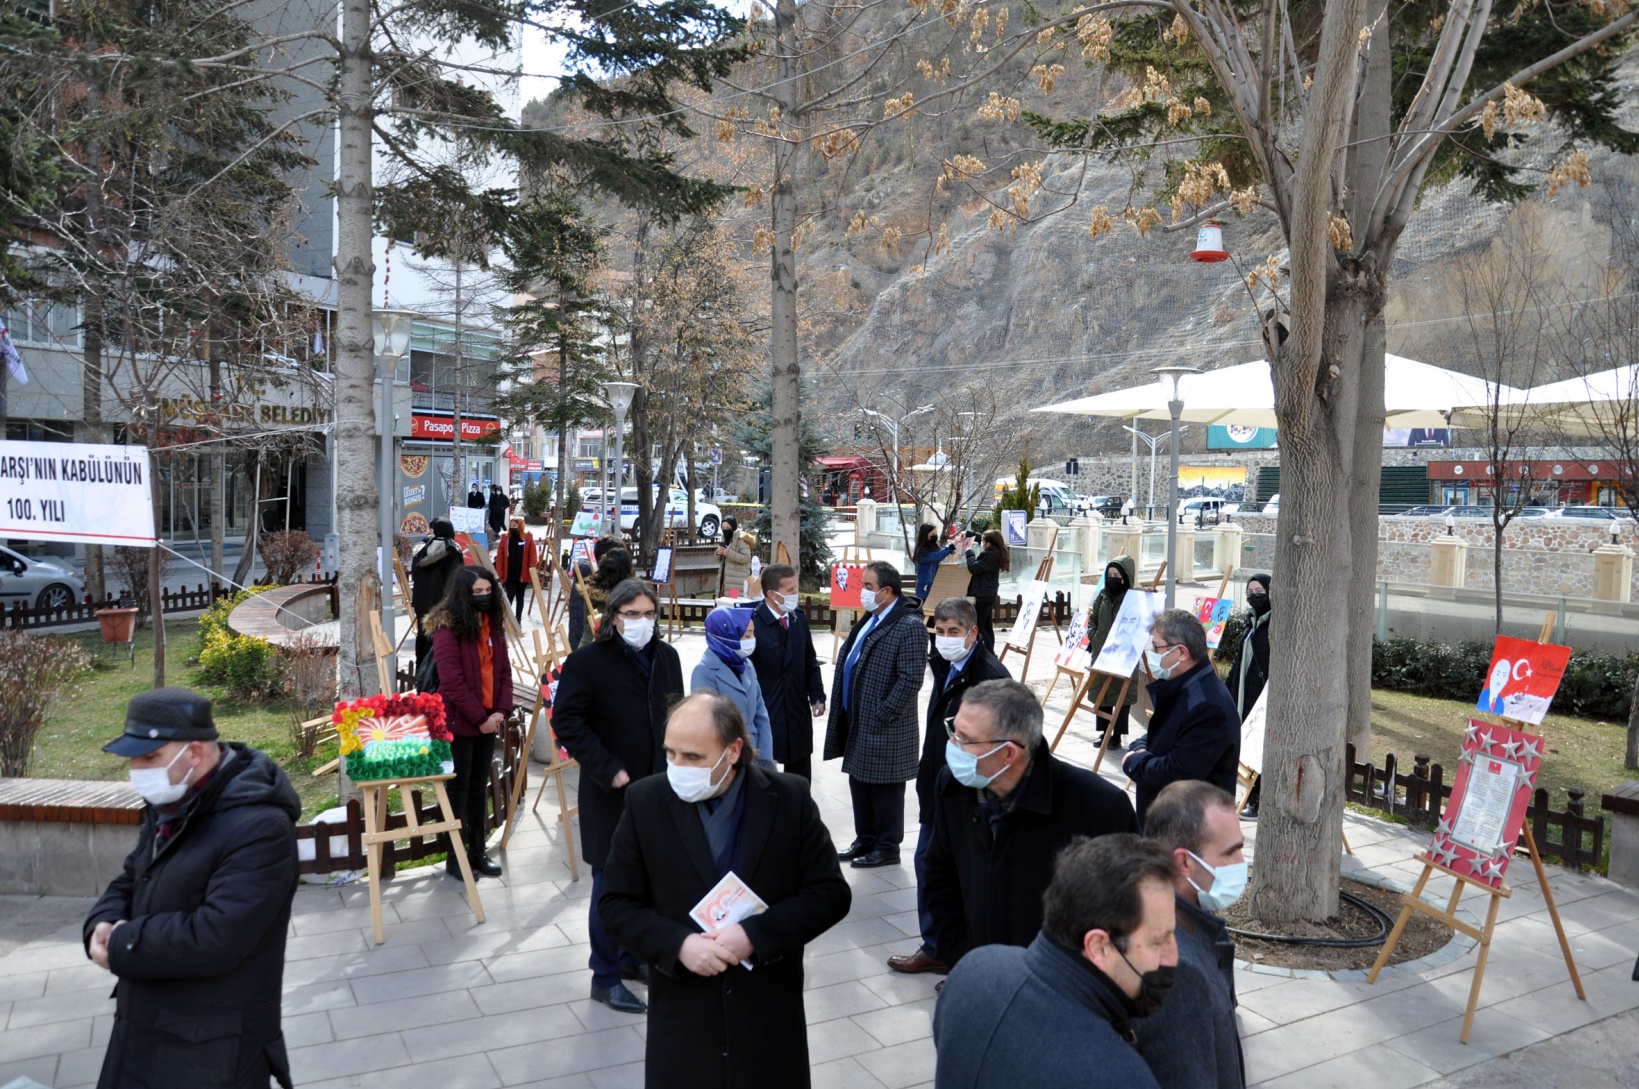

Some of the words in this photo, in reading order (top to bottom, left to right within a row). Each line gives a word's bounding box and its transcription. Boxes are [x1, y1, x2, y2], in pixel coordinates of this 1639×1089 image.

[424, 419, 455, 435] Pasapo
[461, 421, 481, 435] Pizza
[62, 454, 142, 485] KABÜLÜNÜN
[7, 497, 37, 521] 100.
[40, 499, 66, 522] YILI
